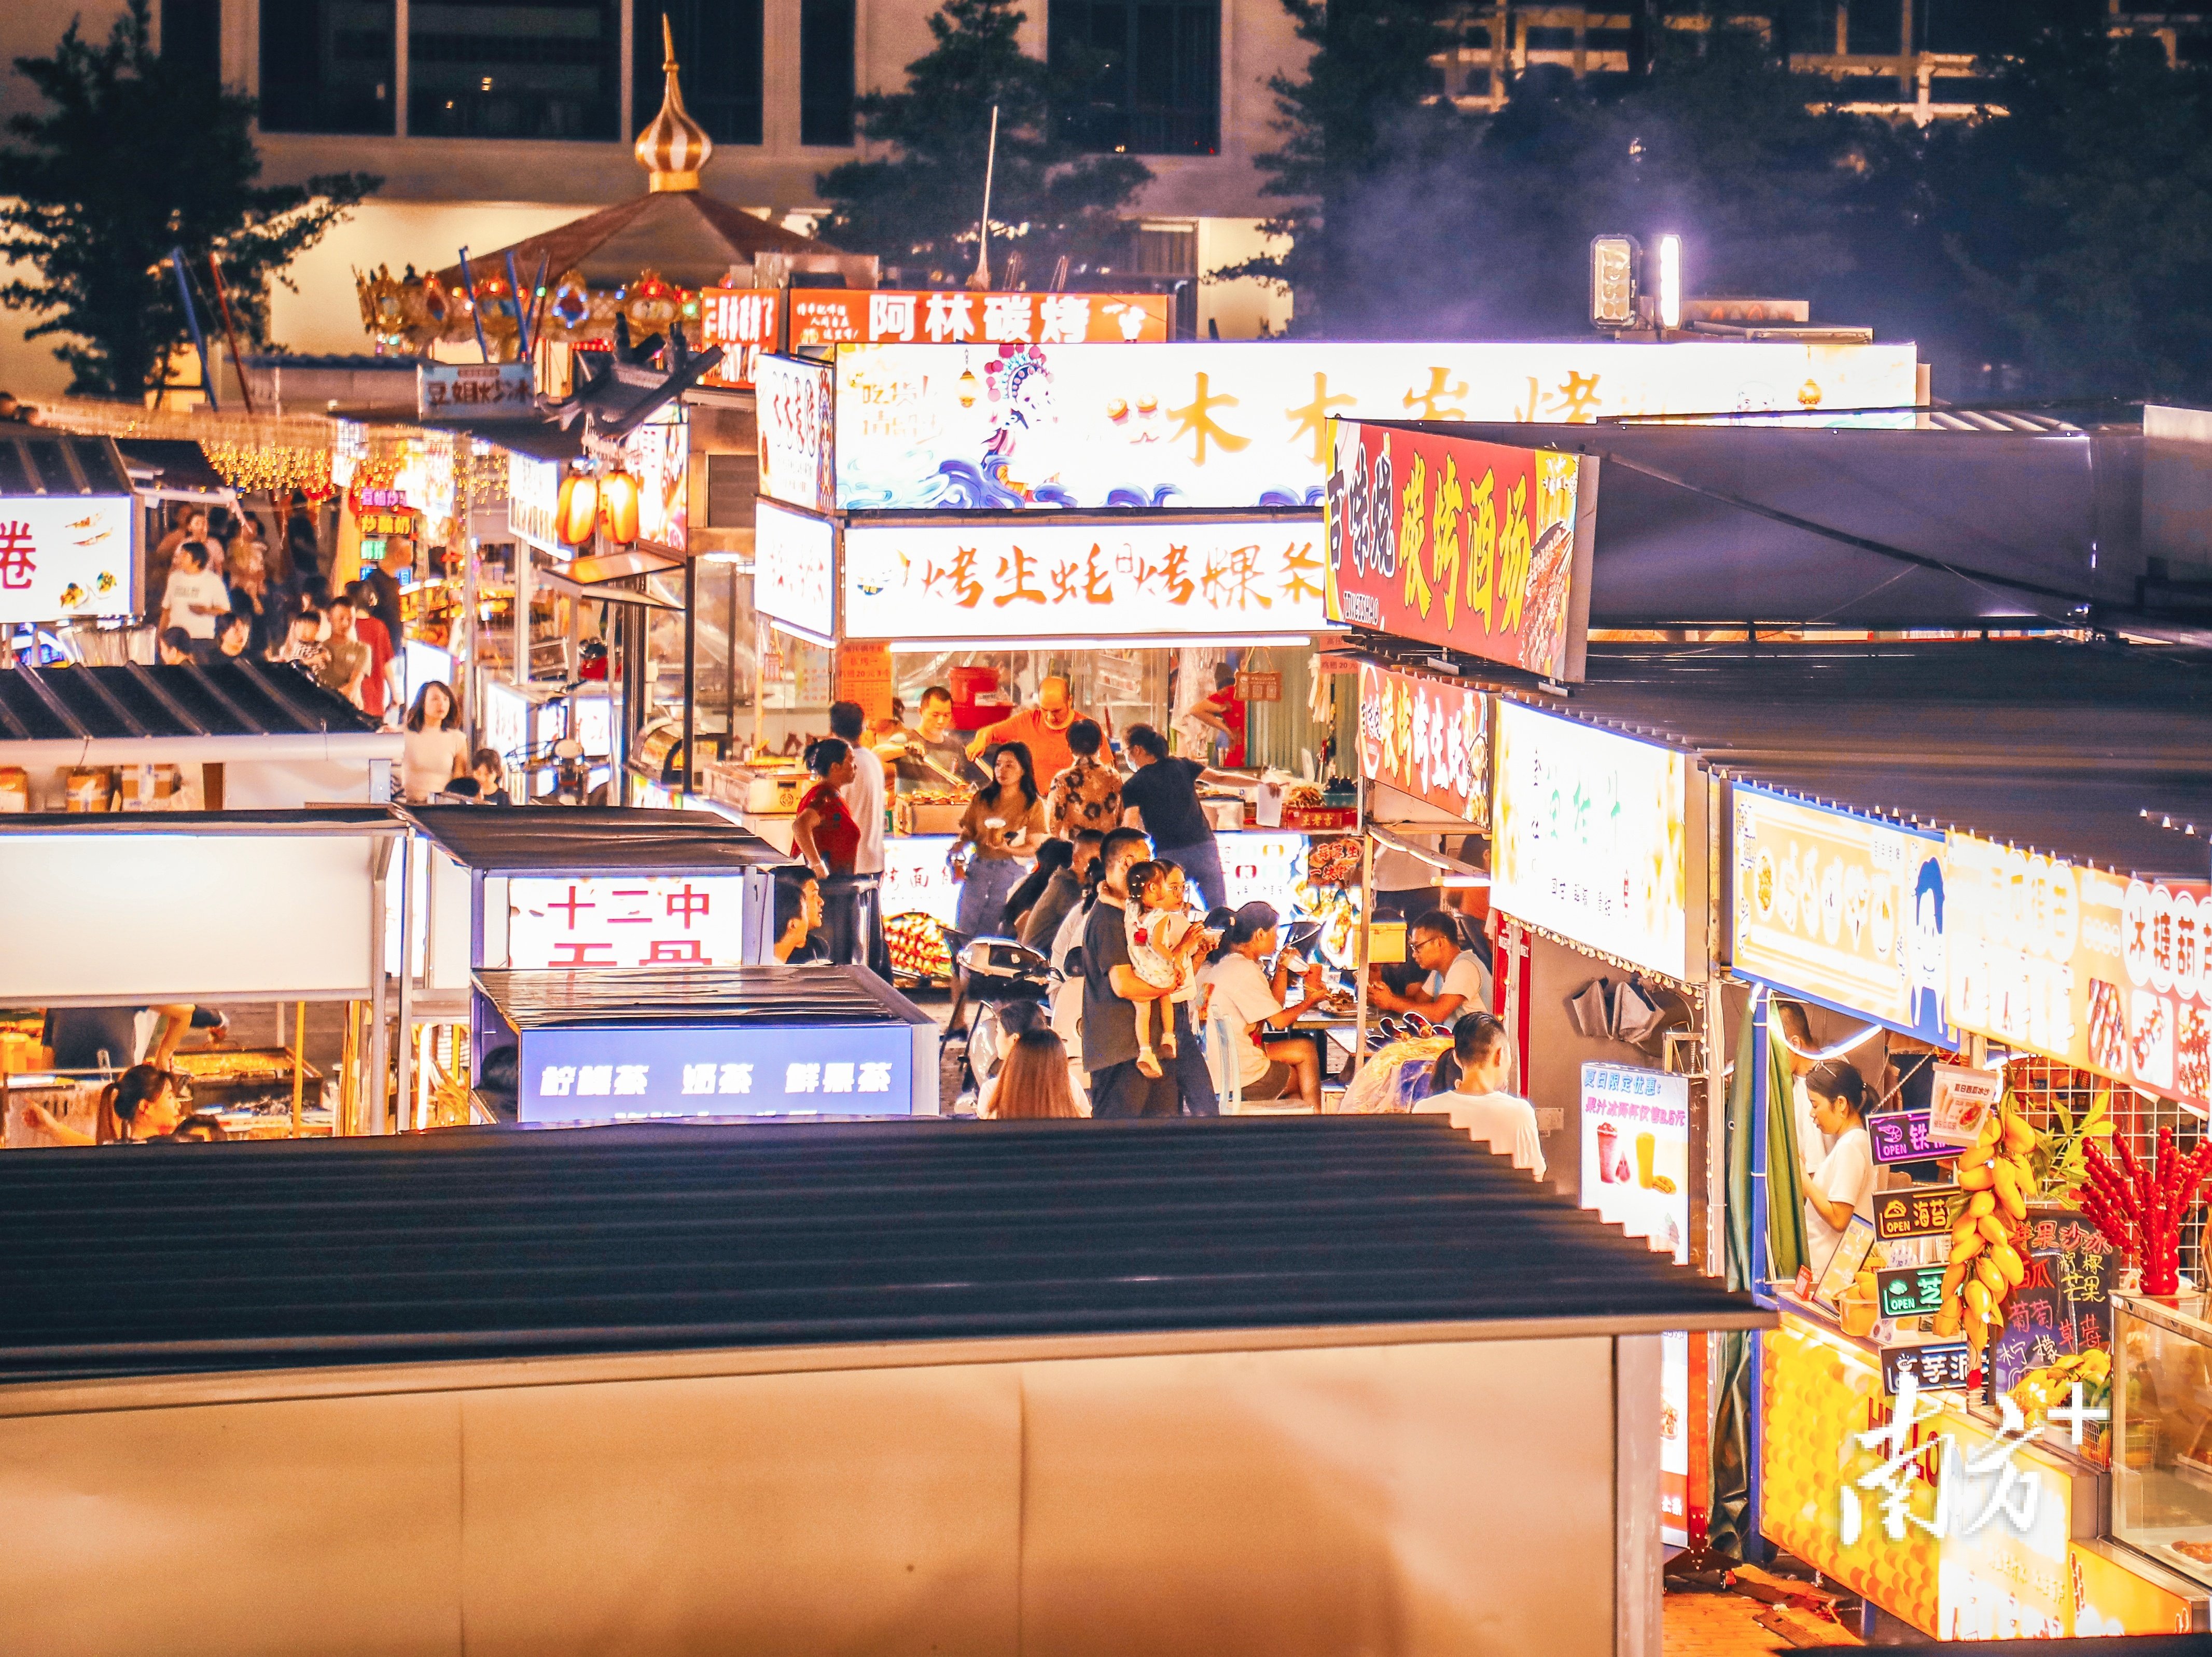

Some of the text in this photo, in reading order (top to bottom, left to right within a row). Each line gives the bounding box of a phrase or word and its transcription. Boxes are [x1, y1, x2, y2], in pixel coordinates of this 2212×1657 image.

[869, 294, 1089, 343] 阿林碳烤
[1301, 813, 1333, 827] 王老吉
[539, 1062, 893, 1096] 柠檬茶 奶茶 鲜果茶
[1883, 1144, 1907, 1156] OPEN
[1886, 1217, 1911, 1233] OPEN
[2061, 1274, 2106, 1302] 芒果
[1890, 1298, 1915, 1310] OPEN
[2008, 1299, 2053, 1332] 葡萄
[2058, 1313, 2102, 1353] 草莓
[1999, 1334, 2064, 1366] 柠檬
